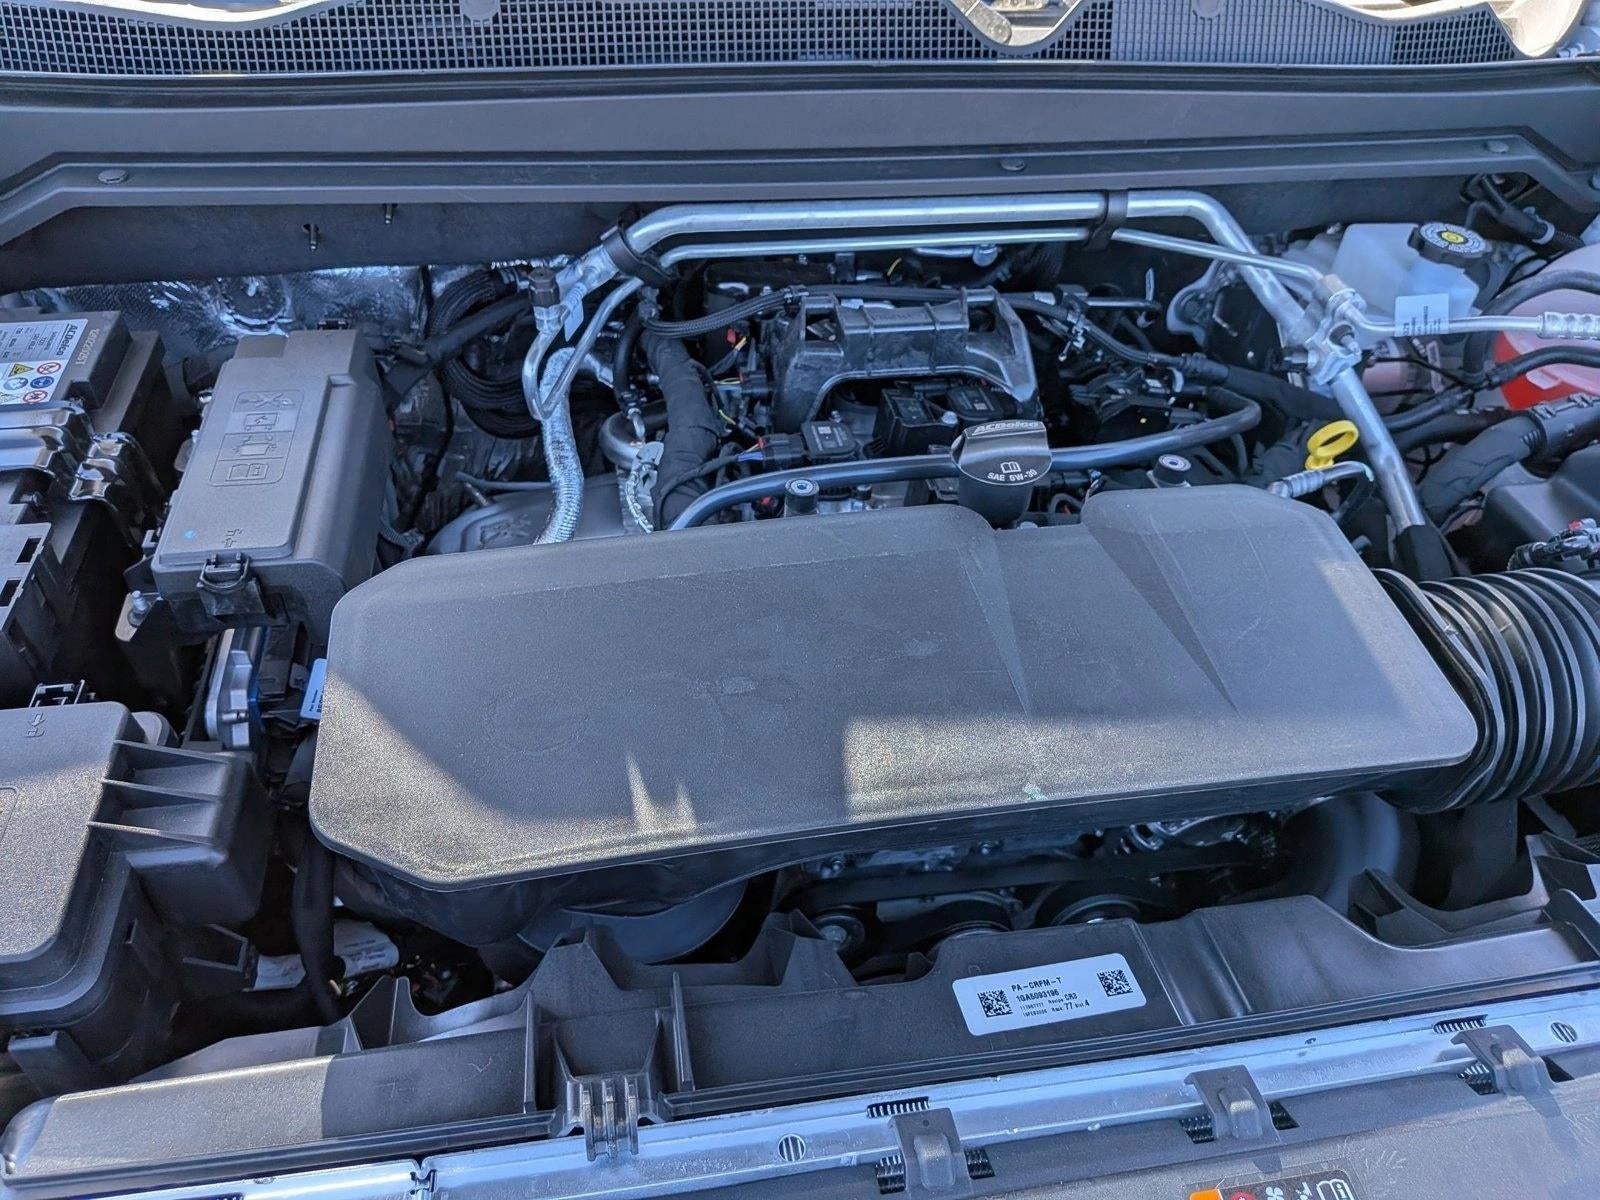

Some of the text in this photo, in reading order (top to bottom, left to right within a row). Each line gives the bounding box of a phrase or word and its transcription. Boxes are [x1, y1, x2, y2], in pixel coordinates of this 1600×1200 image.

[974, 420, 1039, 434] ACDelco
[987, 469, 1038, 482] SAE 5W-30
[1011, 977, 1062, 992] PA-CRFM-T
[1063, 1002, 1073, 1010] 77
[1085, 999, 1090, 1007] 4
